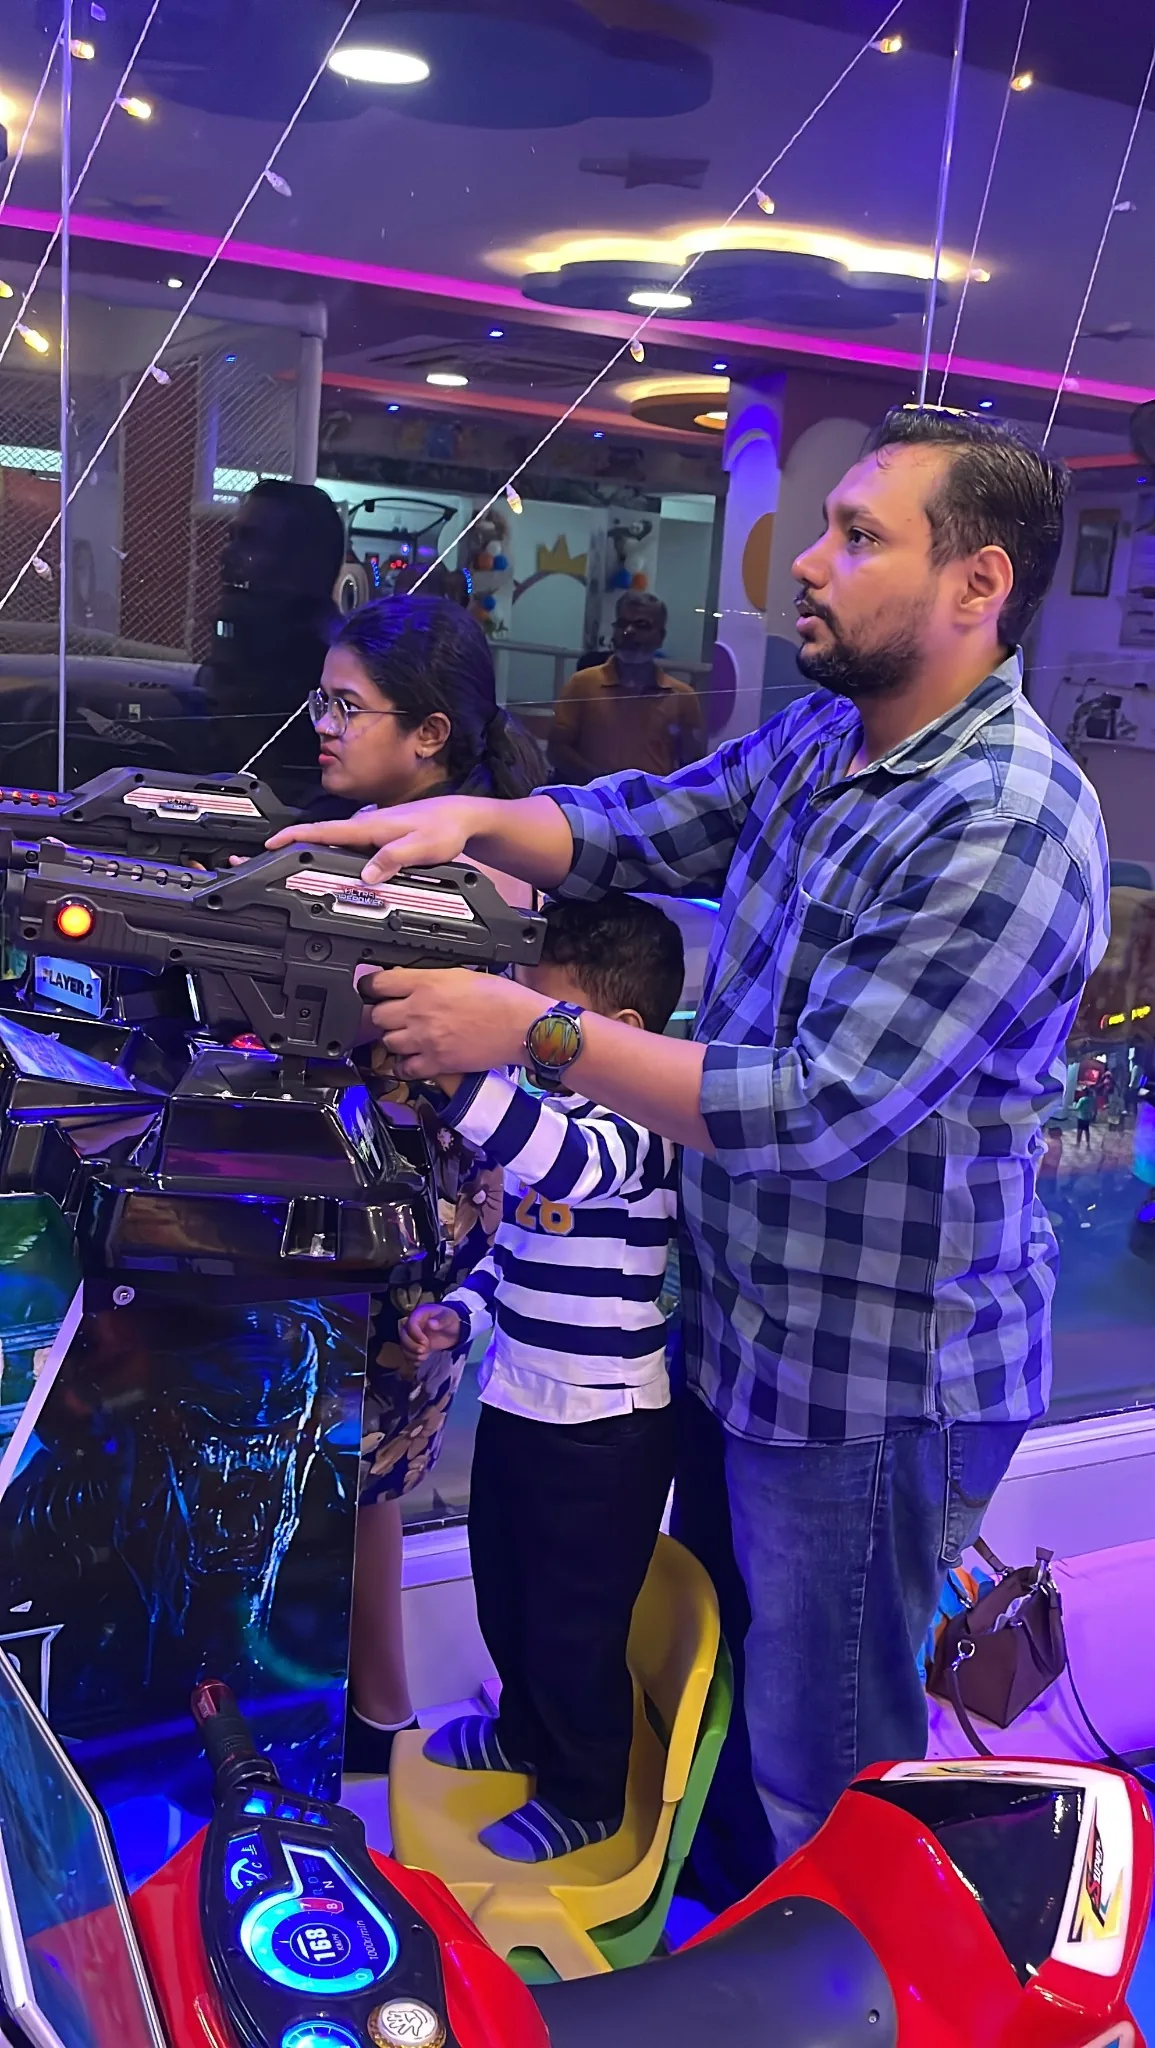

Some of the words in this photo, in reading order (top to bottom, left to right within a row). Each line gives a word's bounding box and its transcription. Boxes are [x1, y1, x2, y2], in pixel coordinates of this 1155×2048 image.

[343, 886, 376, 899] ULTRA
[85, 983, 94, 1001] 2
[322, 1880, 335, 1889] N
[326, 1902, 338, 1910] 8
[304, 1927, 336, 1962] 168
